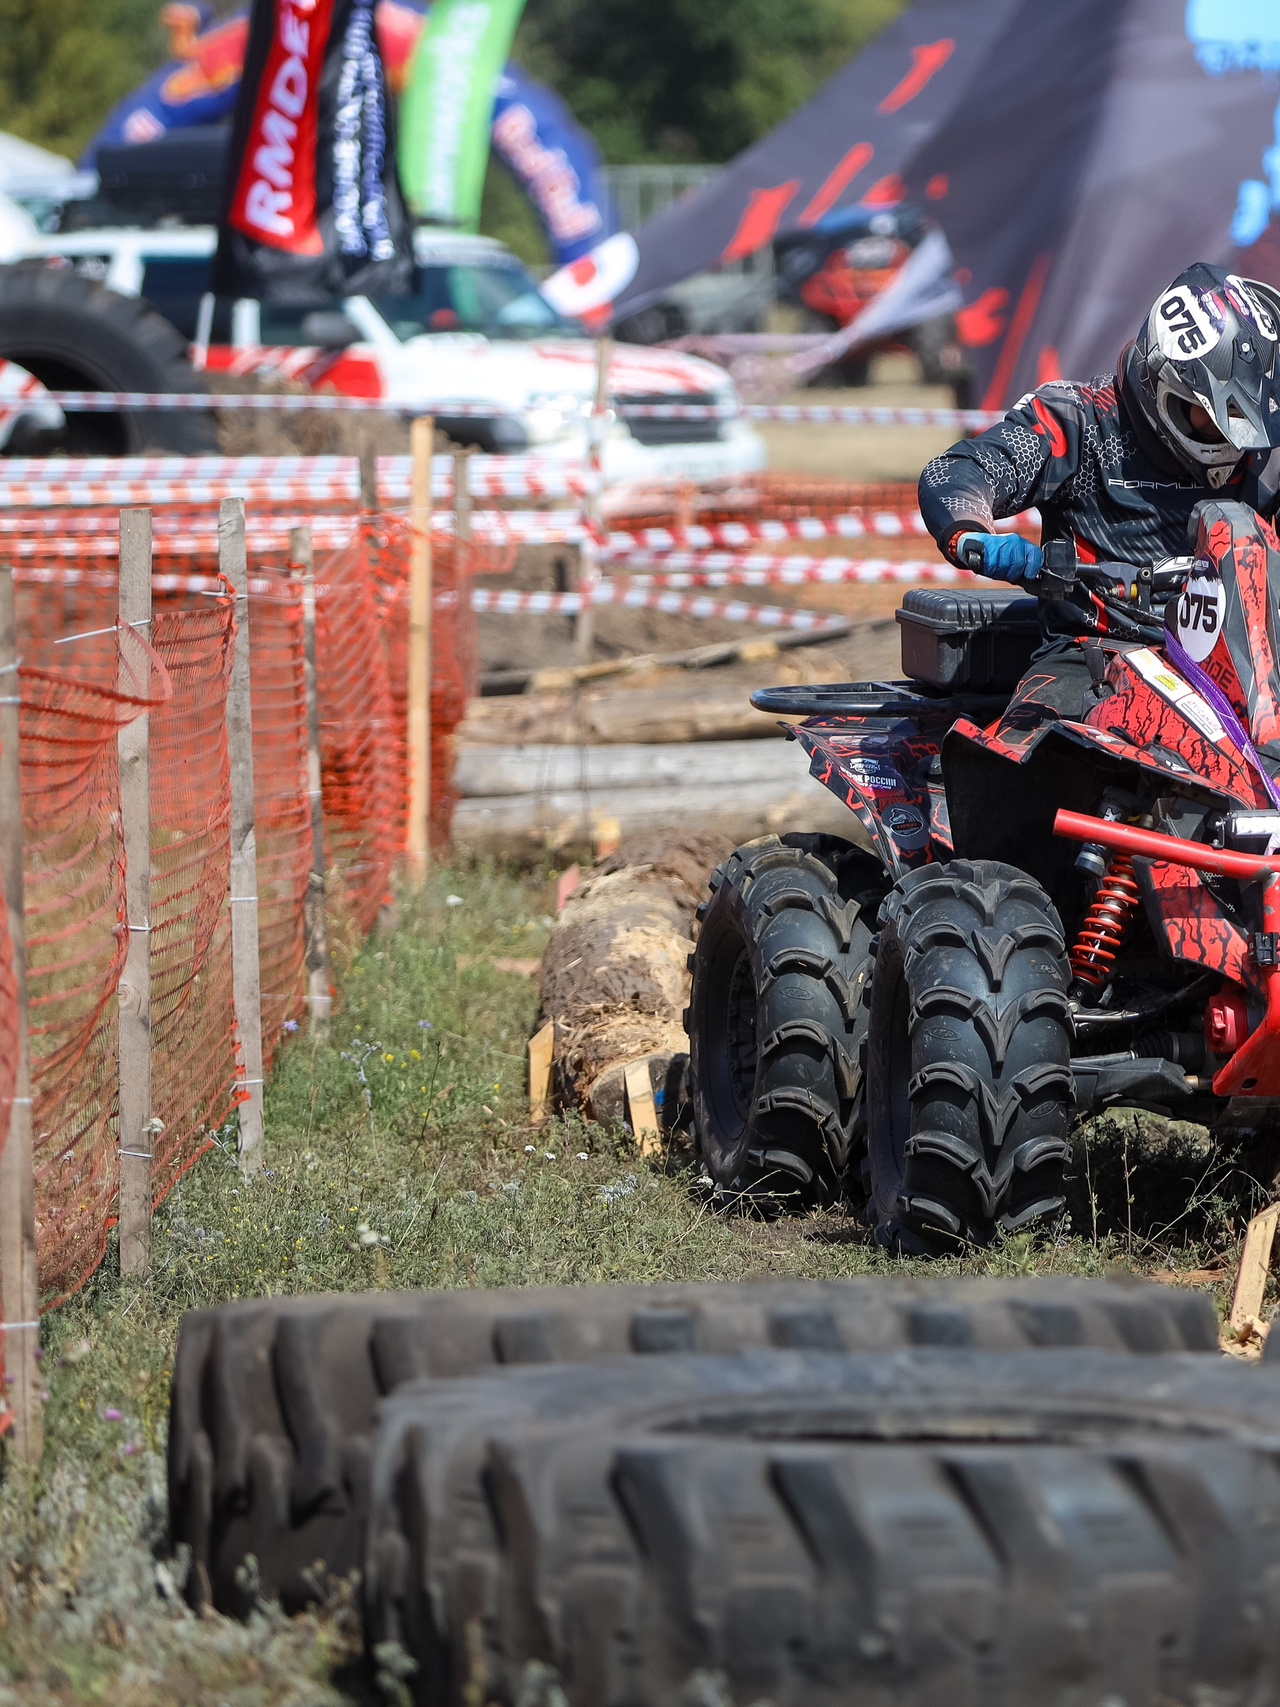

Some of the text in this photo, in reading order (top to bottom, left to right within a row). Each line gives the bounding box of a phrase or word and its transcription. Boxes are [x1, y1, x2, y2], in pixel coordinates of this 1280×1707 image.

[245, 0, 316, 237] RMDE
[1160, 295, 1208, 354] 075
[1108, 478, 1206, 490] FORMUL
[1179, 591, 1219, 633] 075
[864, 774, 897, 787] РОССИИ
